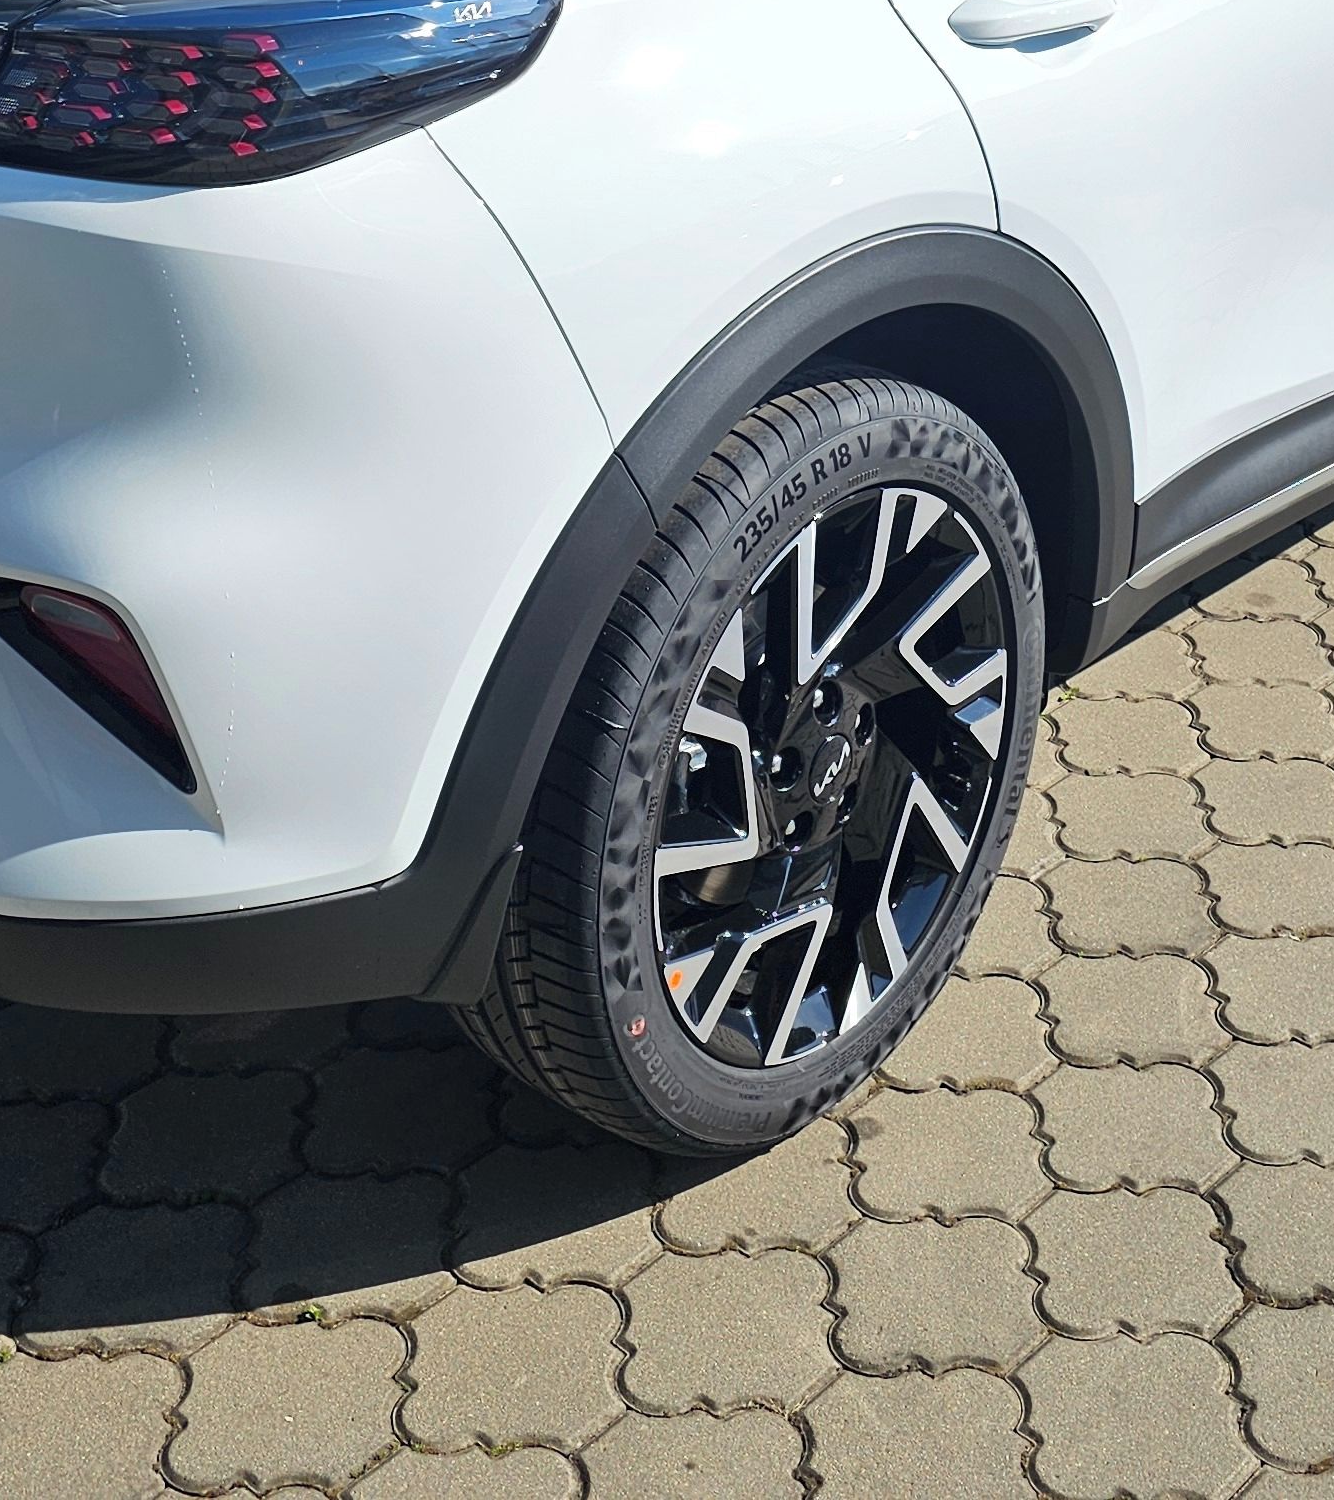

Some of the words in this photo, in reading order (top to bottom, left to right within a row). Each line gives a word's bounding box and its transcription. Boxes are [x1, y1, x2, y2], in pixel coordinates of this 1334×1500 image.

[453, 0, 492, 22] KIA
[733, 472, 807, 563] 235/45
[810, 458, 829, 486] R
[828, 442, 852, 473] 18
[857, 432, 871, 458] V
[813, 741, 851, 797] KIA
